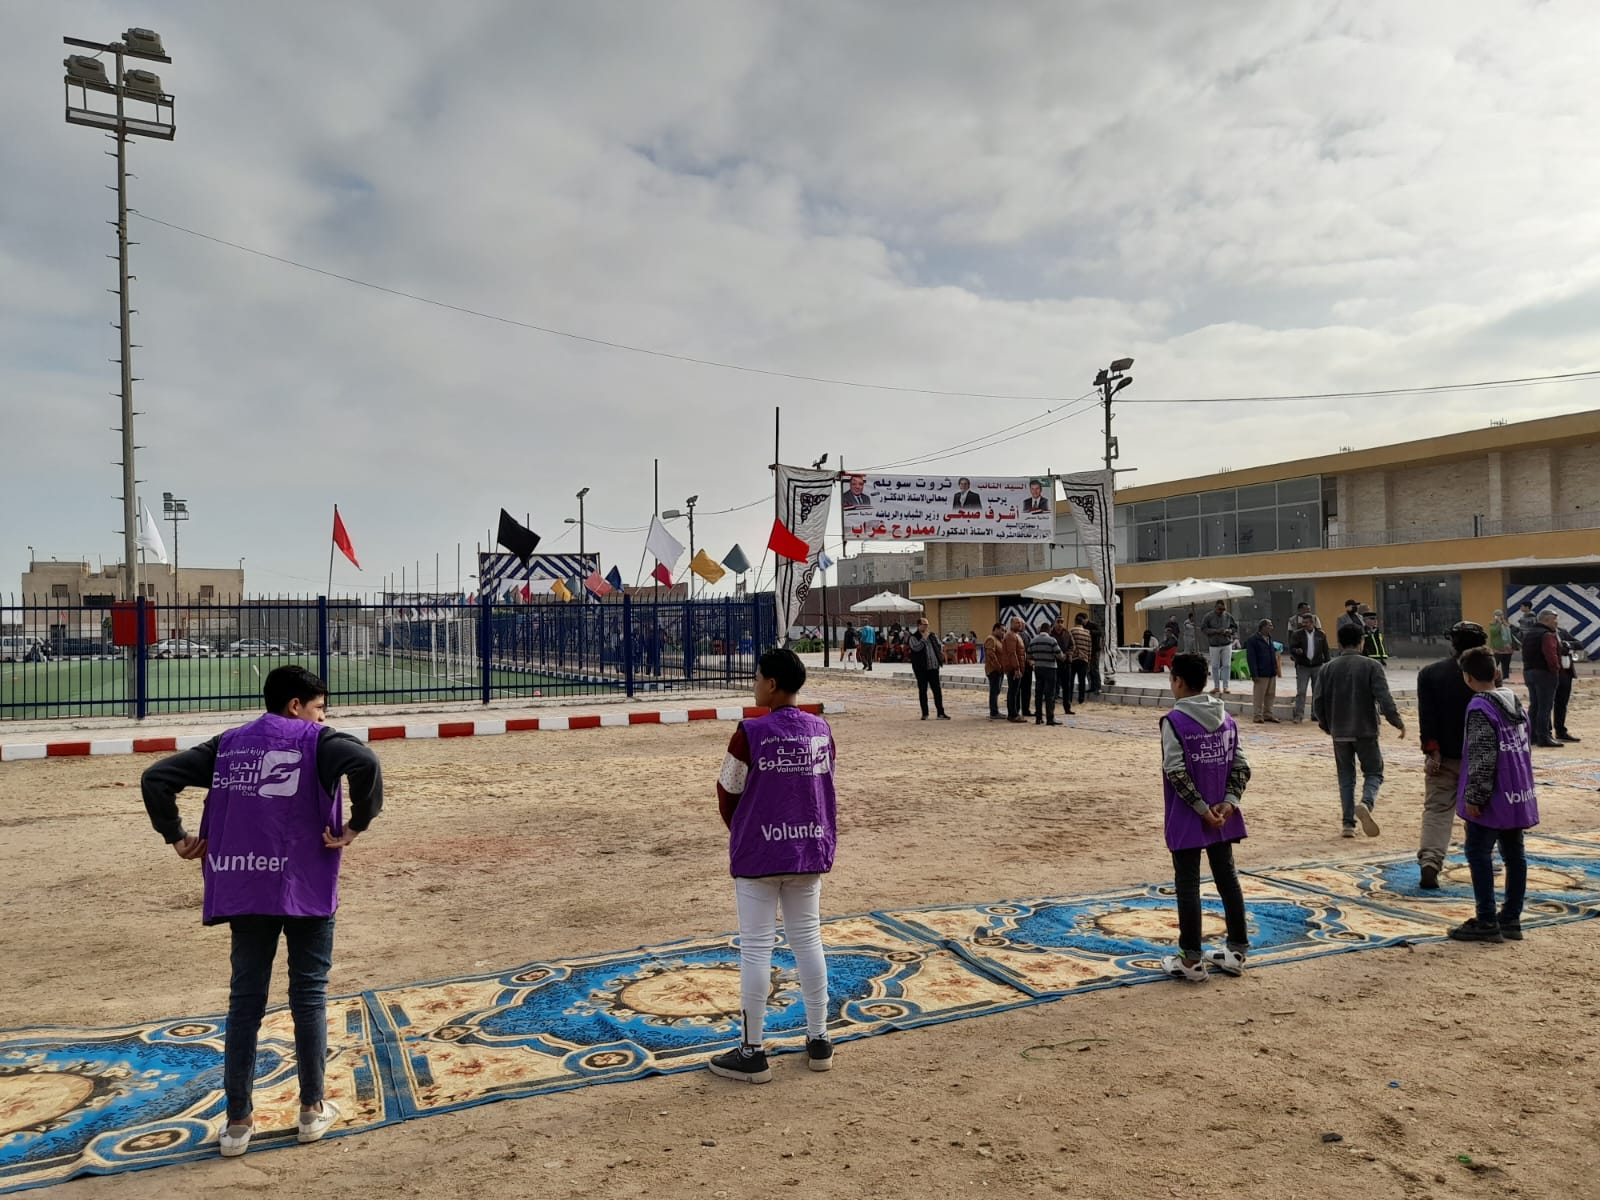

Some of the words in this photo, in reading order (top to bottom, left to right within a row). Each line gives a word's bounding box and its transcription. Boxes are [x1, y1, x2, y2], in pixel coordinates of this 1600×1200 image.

[873, 478, 911, 490] سويلم
[915, 478, 952, 490] ثروت
[977, 480, 1002, 491] النائب
[1004, 481, 1027, 491] السيد
[879, 493, 906, 503] الدكتور
[987, 495, 1008, 505] يرحب
[903, 508, 924, 520] الشباب
[924, 510, 940, 521] وزير
[984, 505, 1020, 522] أشرف
[851, 520, 888, 538] غراب
[890, 522, 936, 539] ممدوح
[969, 528, 994, 537] الاستاذ
[1191, 748, 1225, 762] التطو
[229, 756, 262, 772] أندية
[758, 755, 812, 771] التطوع
